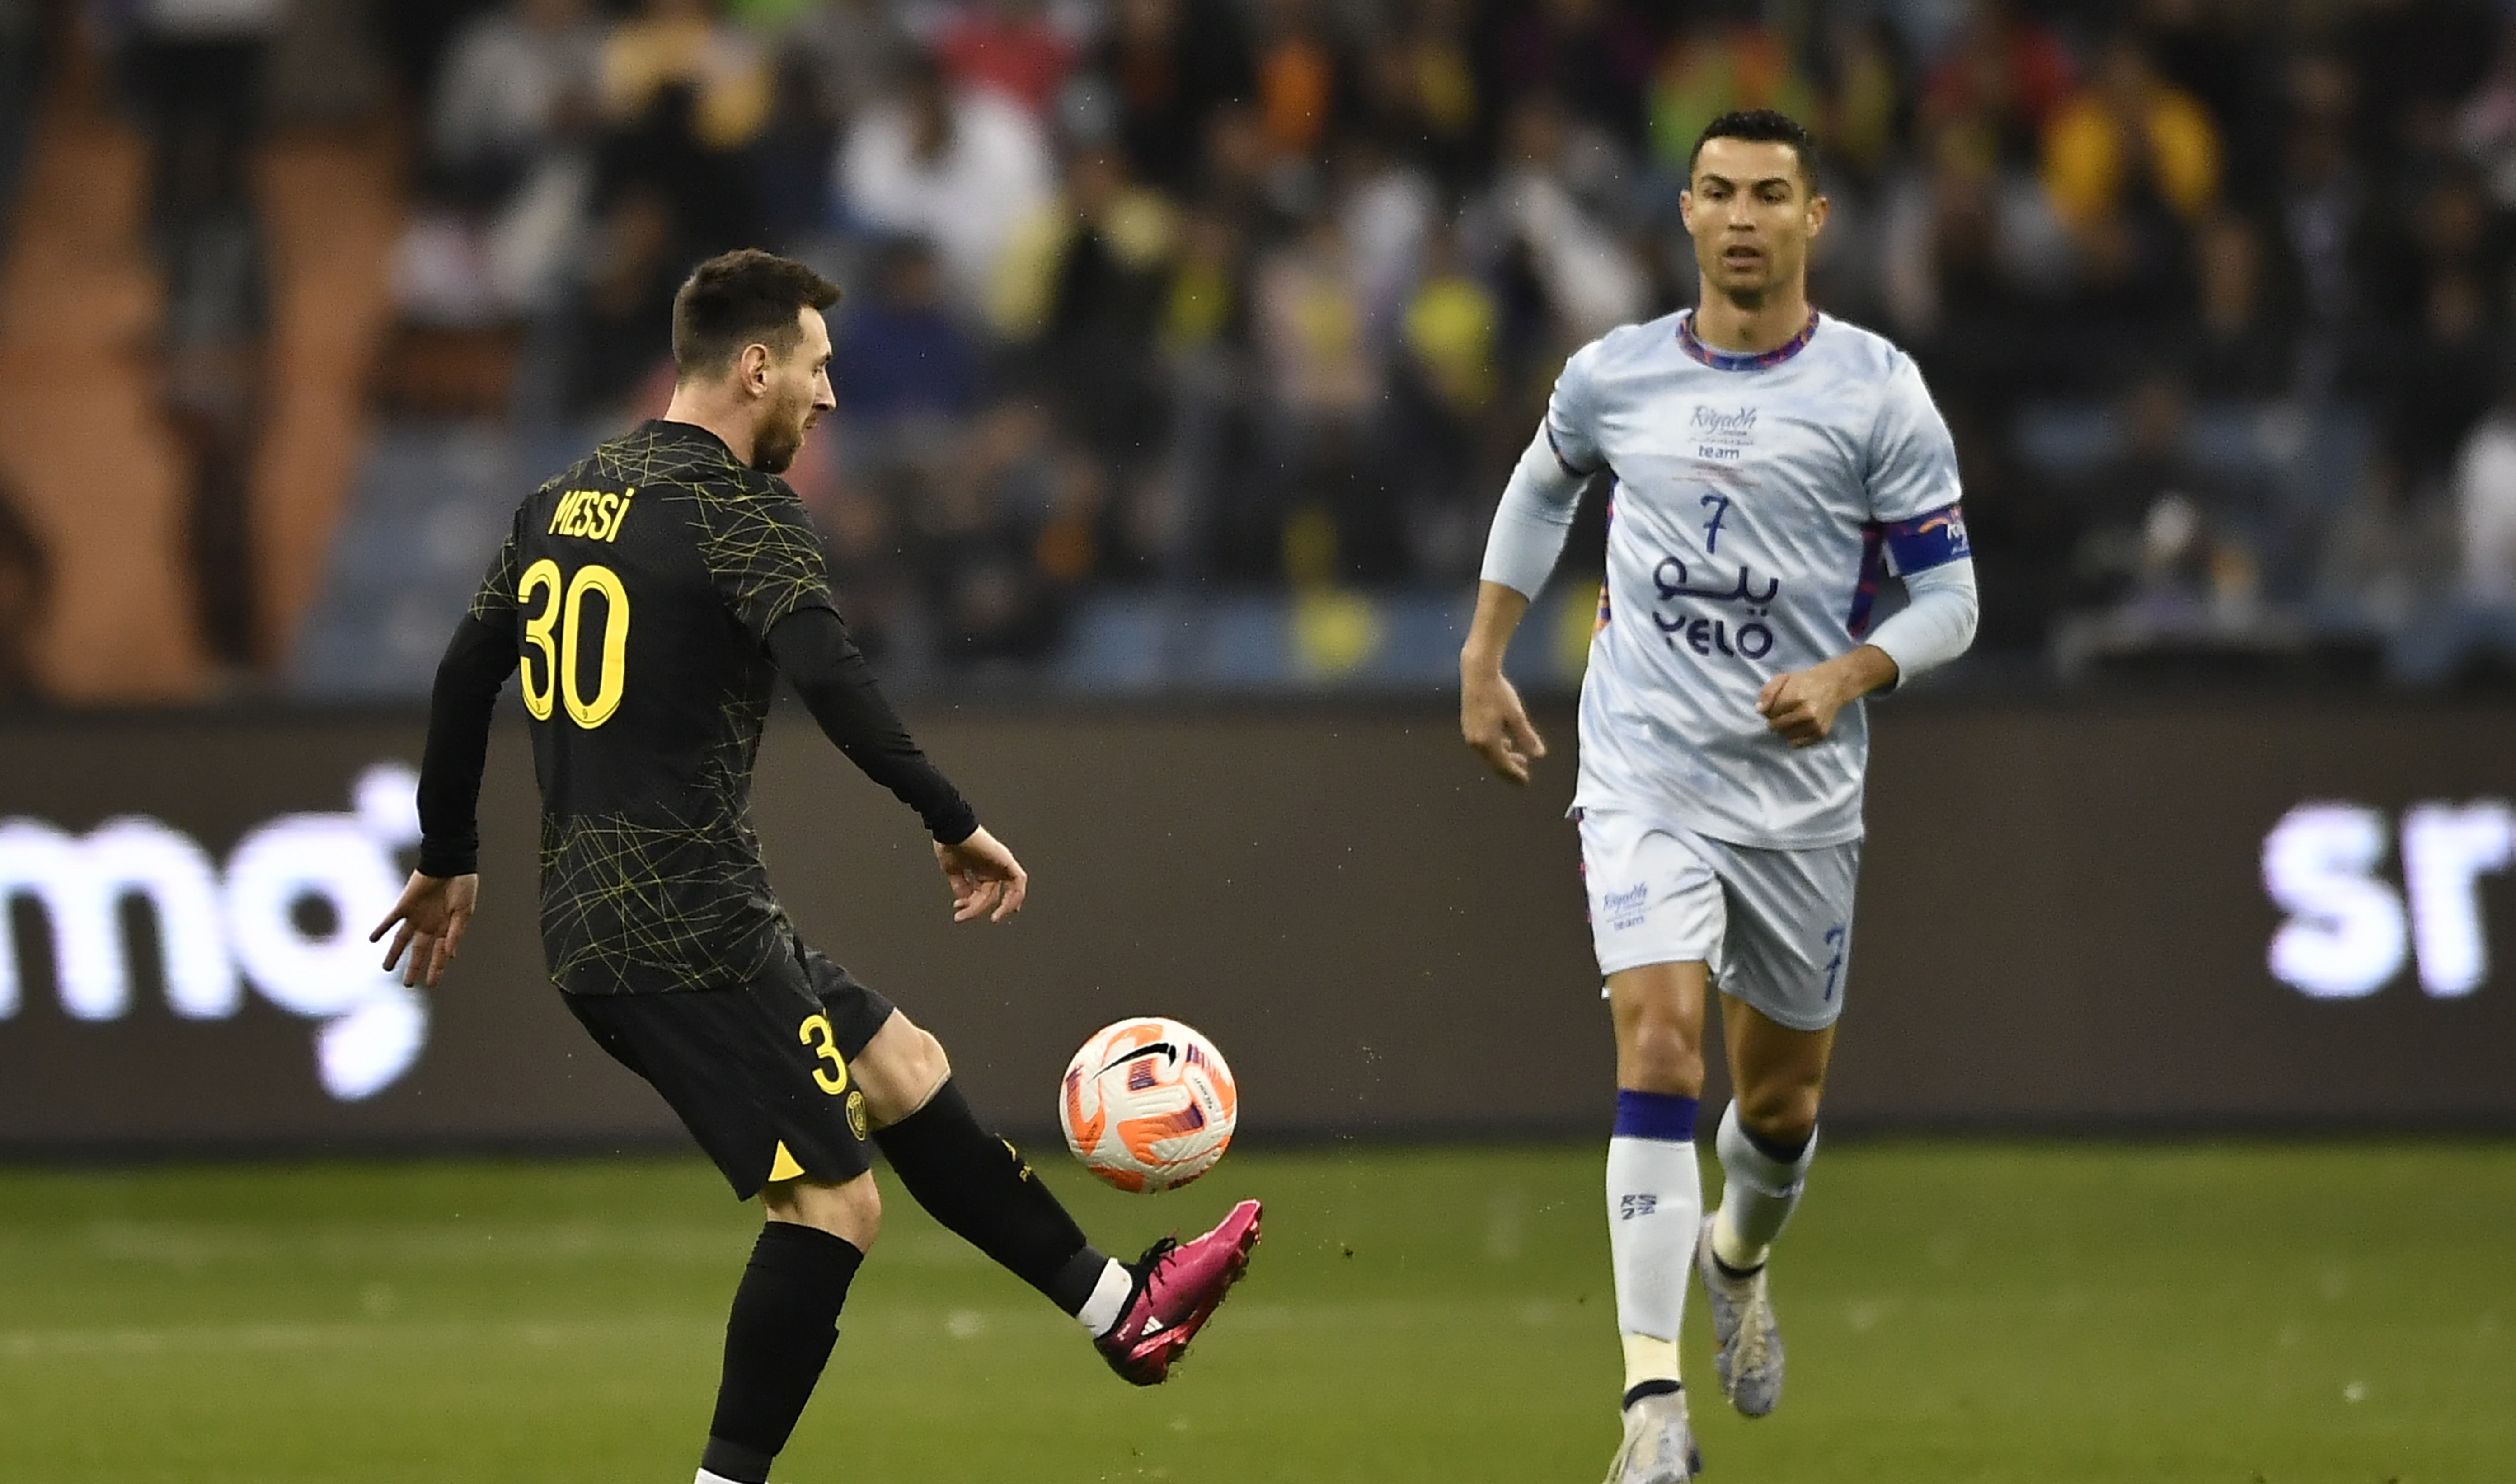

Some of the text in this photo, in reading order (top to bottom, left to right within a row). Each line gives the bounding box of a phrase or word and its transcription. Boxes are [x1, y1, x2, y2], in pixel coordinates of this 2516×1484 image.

[1698, 444, 1740, 459] team
[1700, 494, 1730, 554] 7
[518, 559, 629, 730] 30
[1824, 926, 1846, 1002] 7
[799, 1007, 848, 1095] 3
